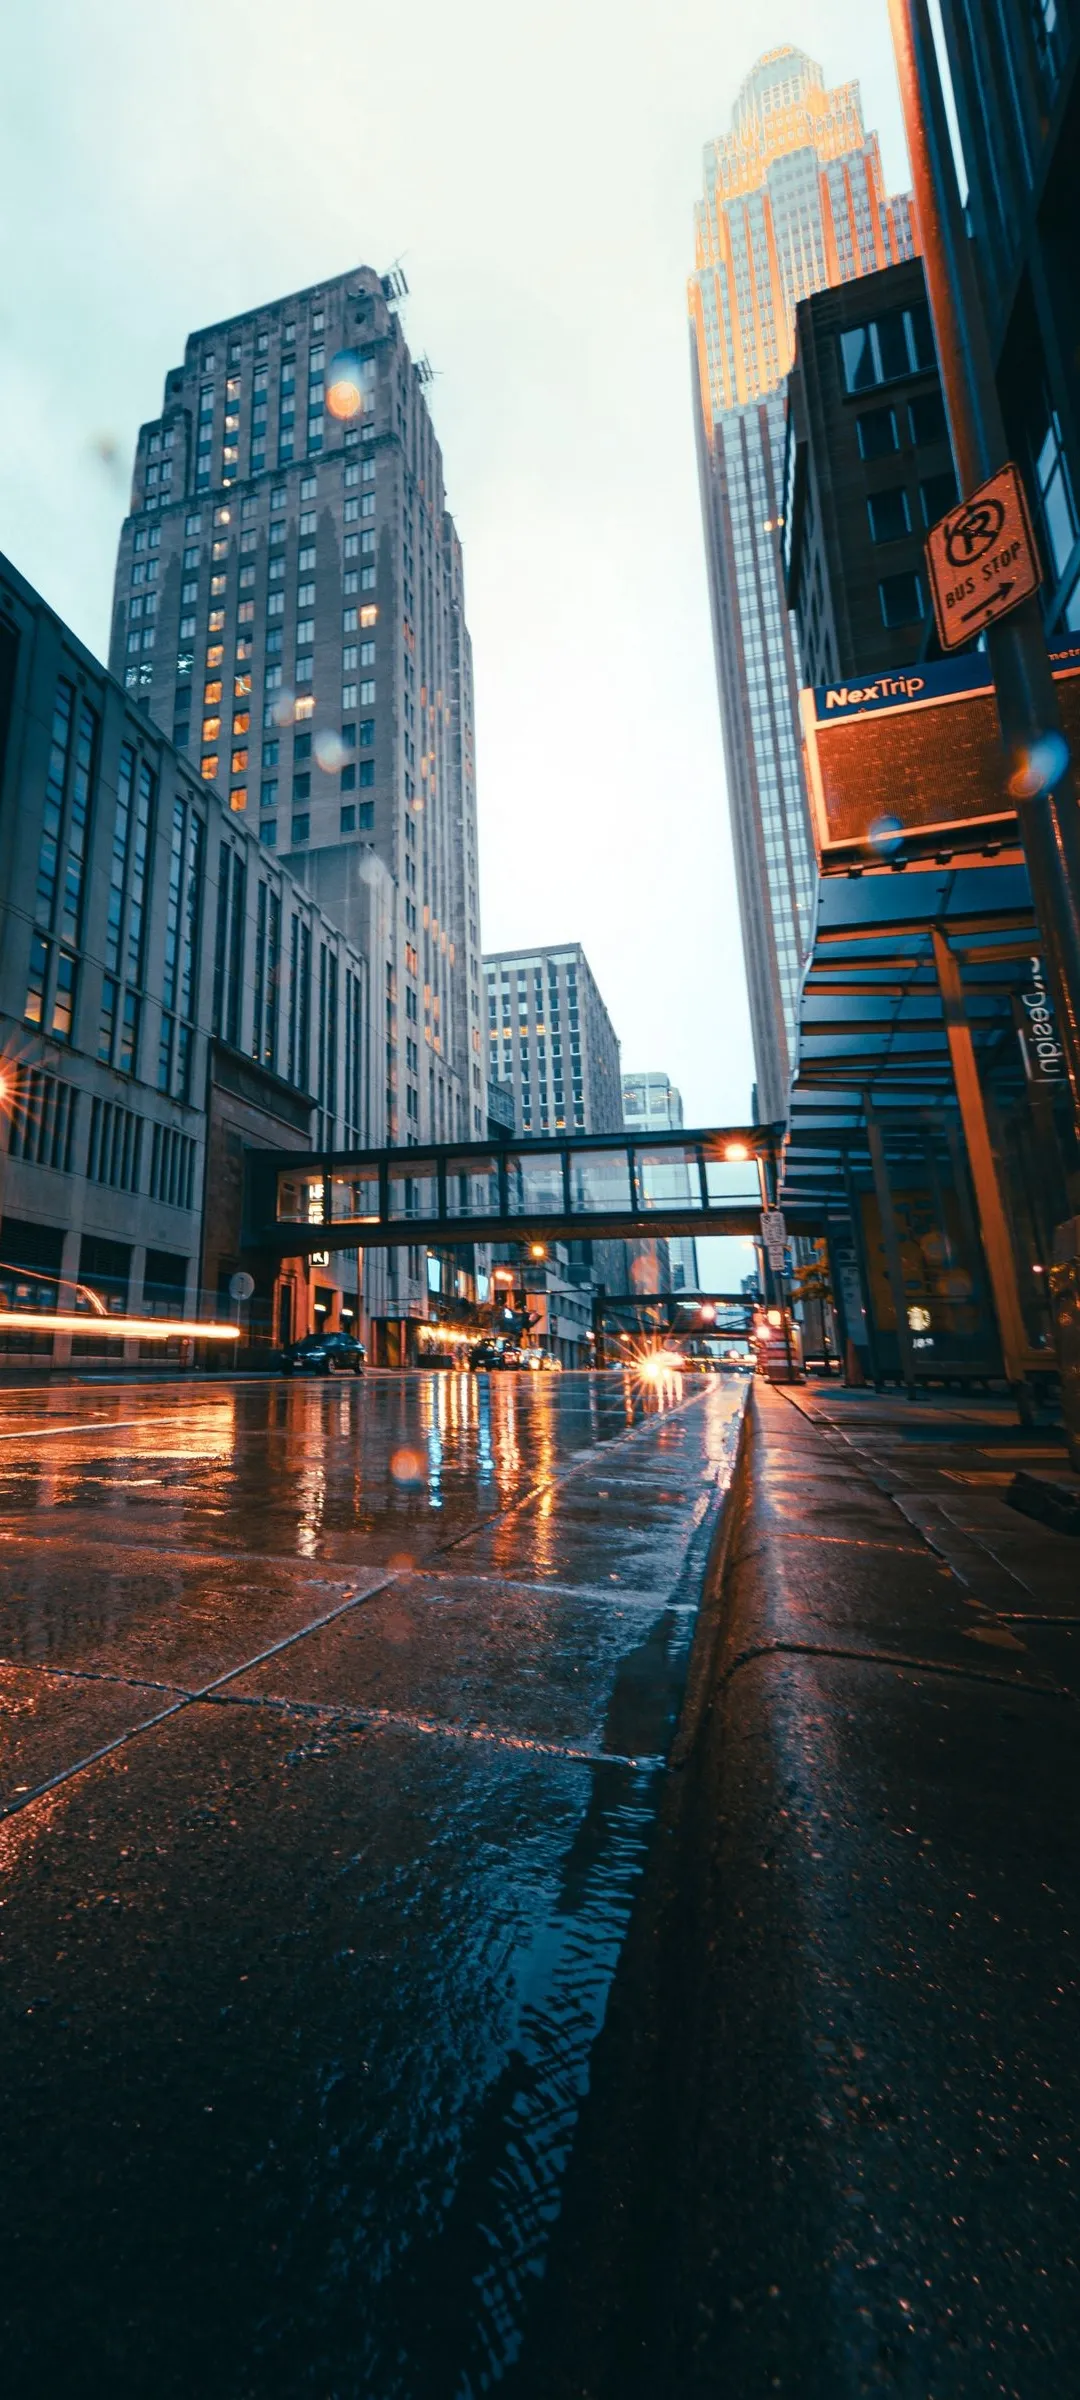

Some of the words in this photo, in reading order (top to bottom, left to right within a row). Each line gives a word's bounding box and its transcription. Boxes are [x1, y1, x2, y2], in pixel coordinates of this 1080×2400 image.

[946, 577, 975, 608] BUS
[982, 541, 1021, 581] STOP
[826, 676, 924, 708] NexTrip
